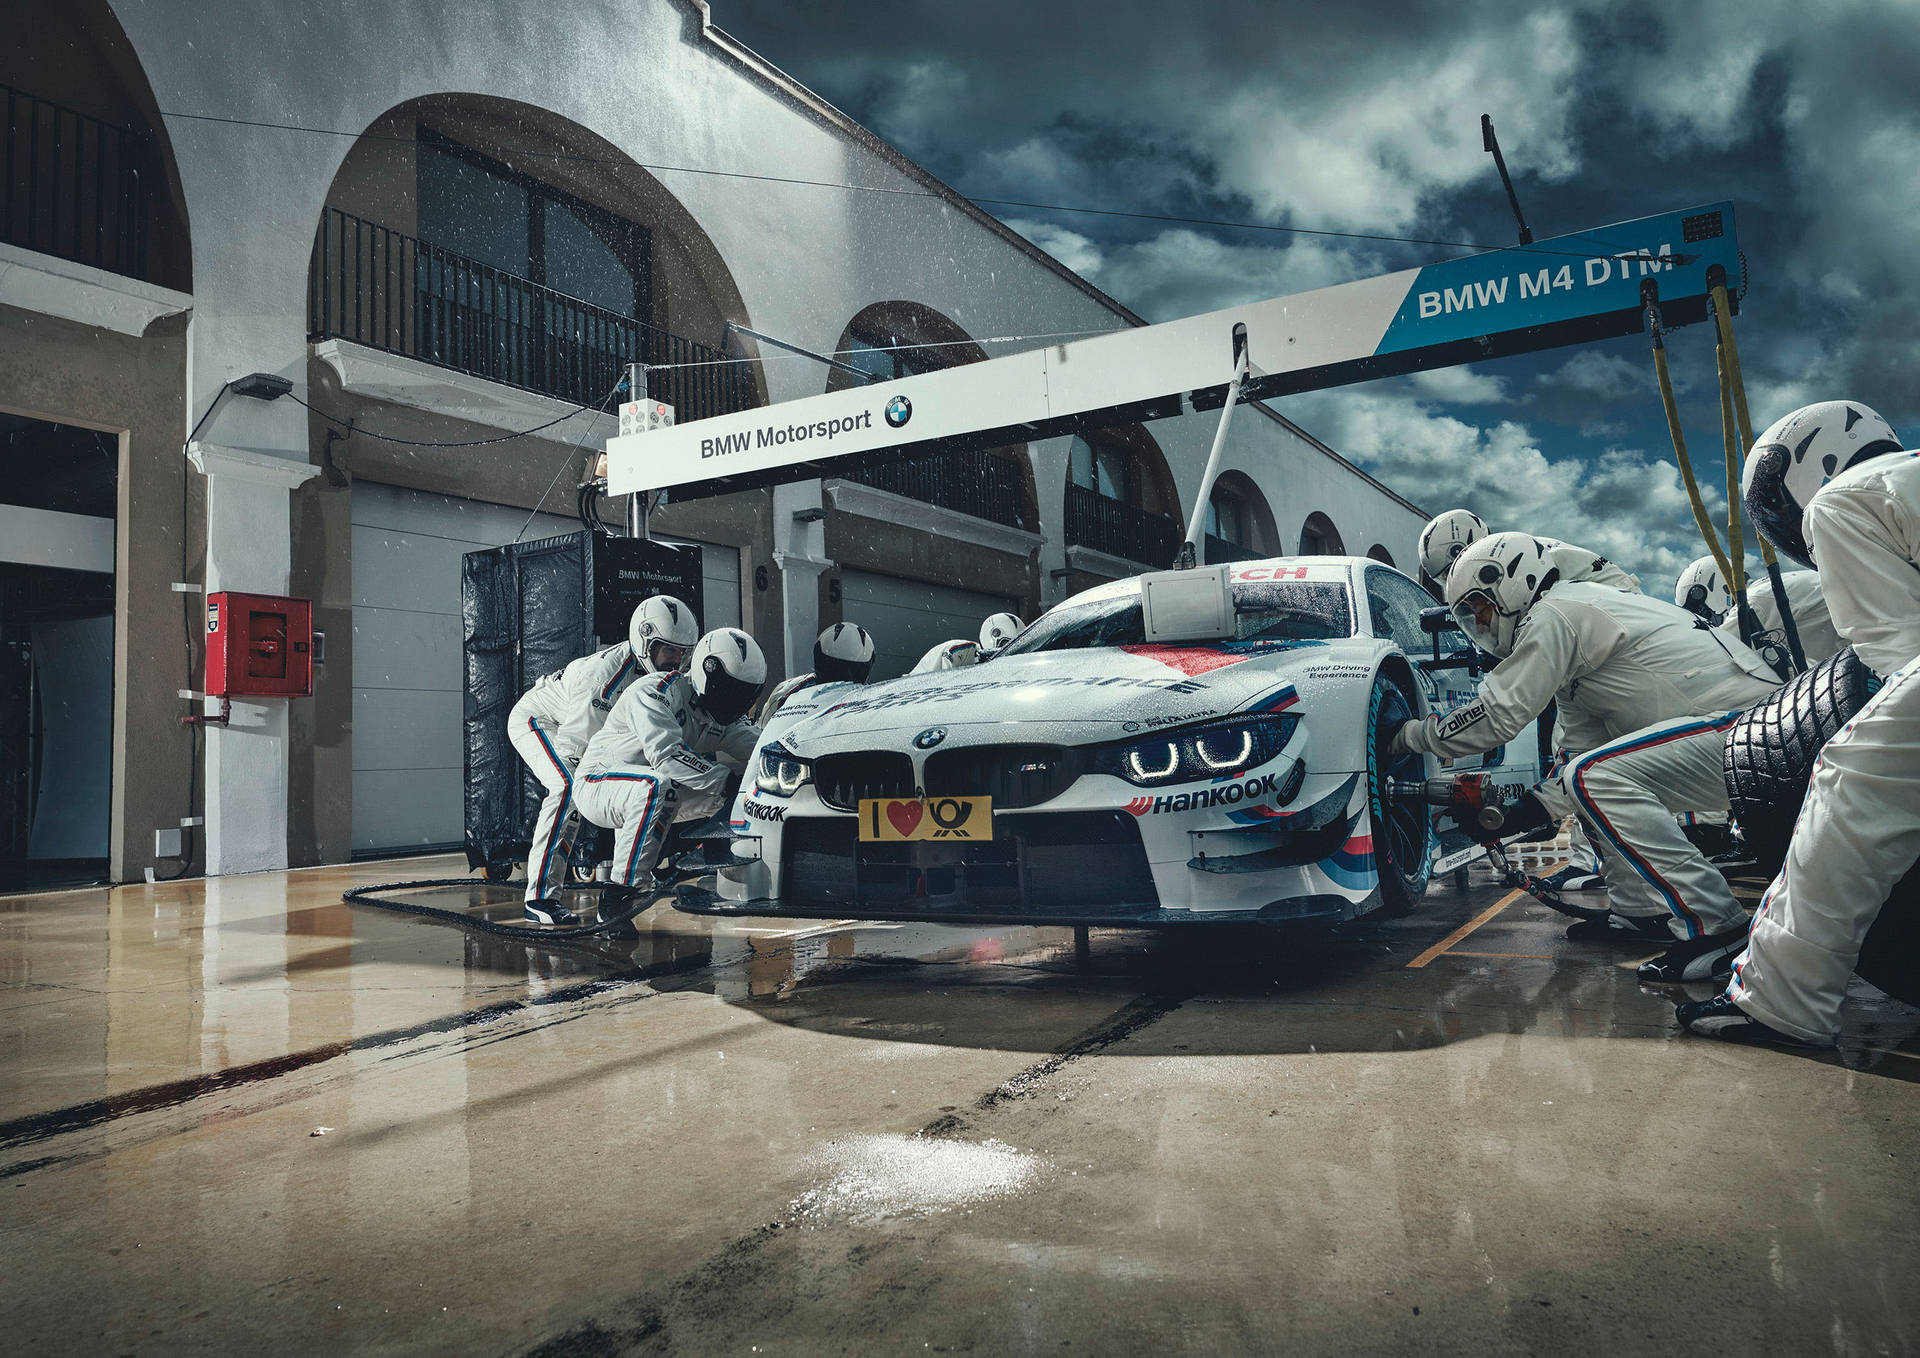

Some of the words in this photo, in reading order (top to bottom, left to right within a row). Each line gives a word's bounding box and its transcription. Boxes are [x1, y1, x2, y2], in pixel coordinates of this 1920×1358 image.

[1419, 276, 1509, 319] BMW
[1519, 265, 1574, 299] M4
[1585, 244, 1673, 286] DTM
[701, 432, 751, 459] BMW
[757, 410, 872, 448] Motorsport
[618, 569, 640, 580] BMW
[755, 565, 768, 592] 6
[1184, 710, 1218, 720] ULTRA
[872, 802, 880, 838] I
